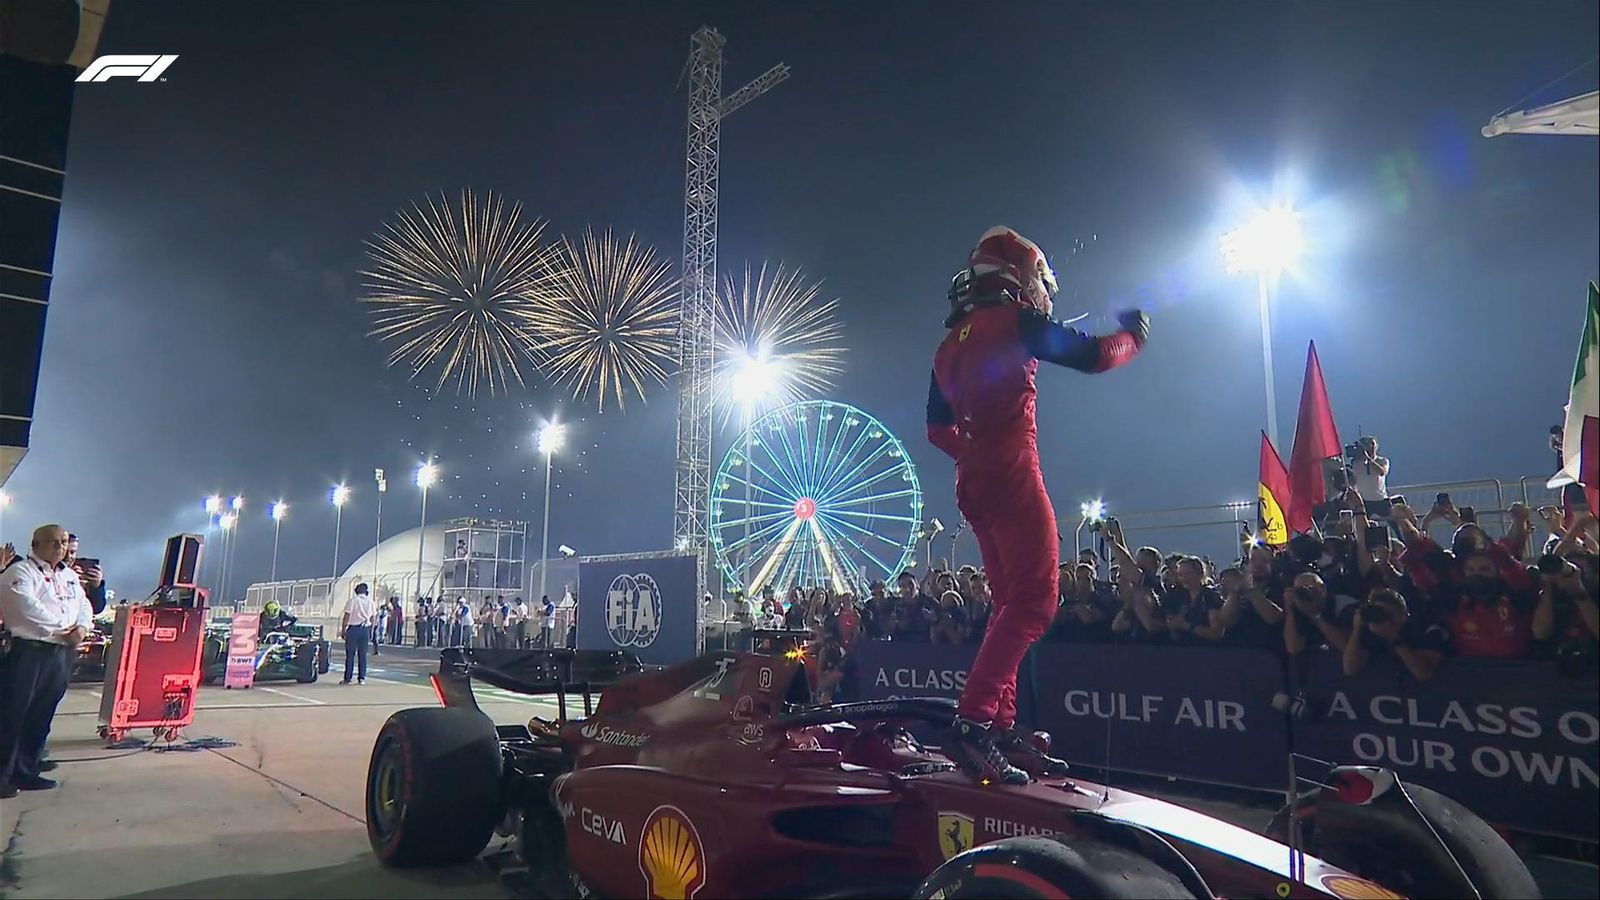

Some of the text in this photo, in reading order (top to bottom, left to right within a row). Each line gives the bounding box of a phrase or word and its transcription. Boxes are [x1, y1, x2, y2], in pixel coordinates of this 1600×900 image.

[609, 588, 656, 632] FIA
[874, 667, 968, 691] A CLASS
[1064, 690, 1247, 731] GULF AIR
[1327, 691, 1357, 720] A
[1369, 695, 1543, 739] CLASS
[596, 725, 651, 747] Santander
[1352, 732, 1599, 789] OUR OWN
